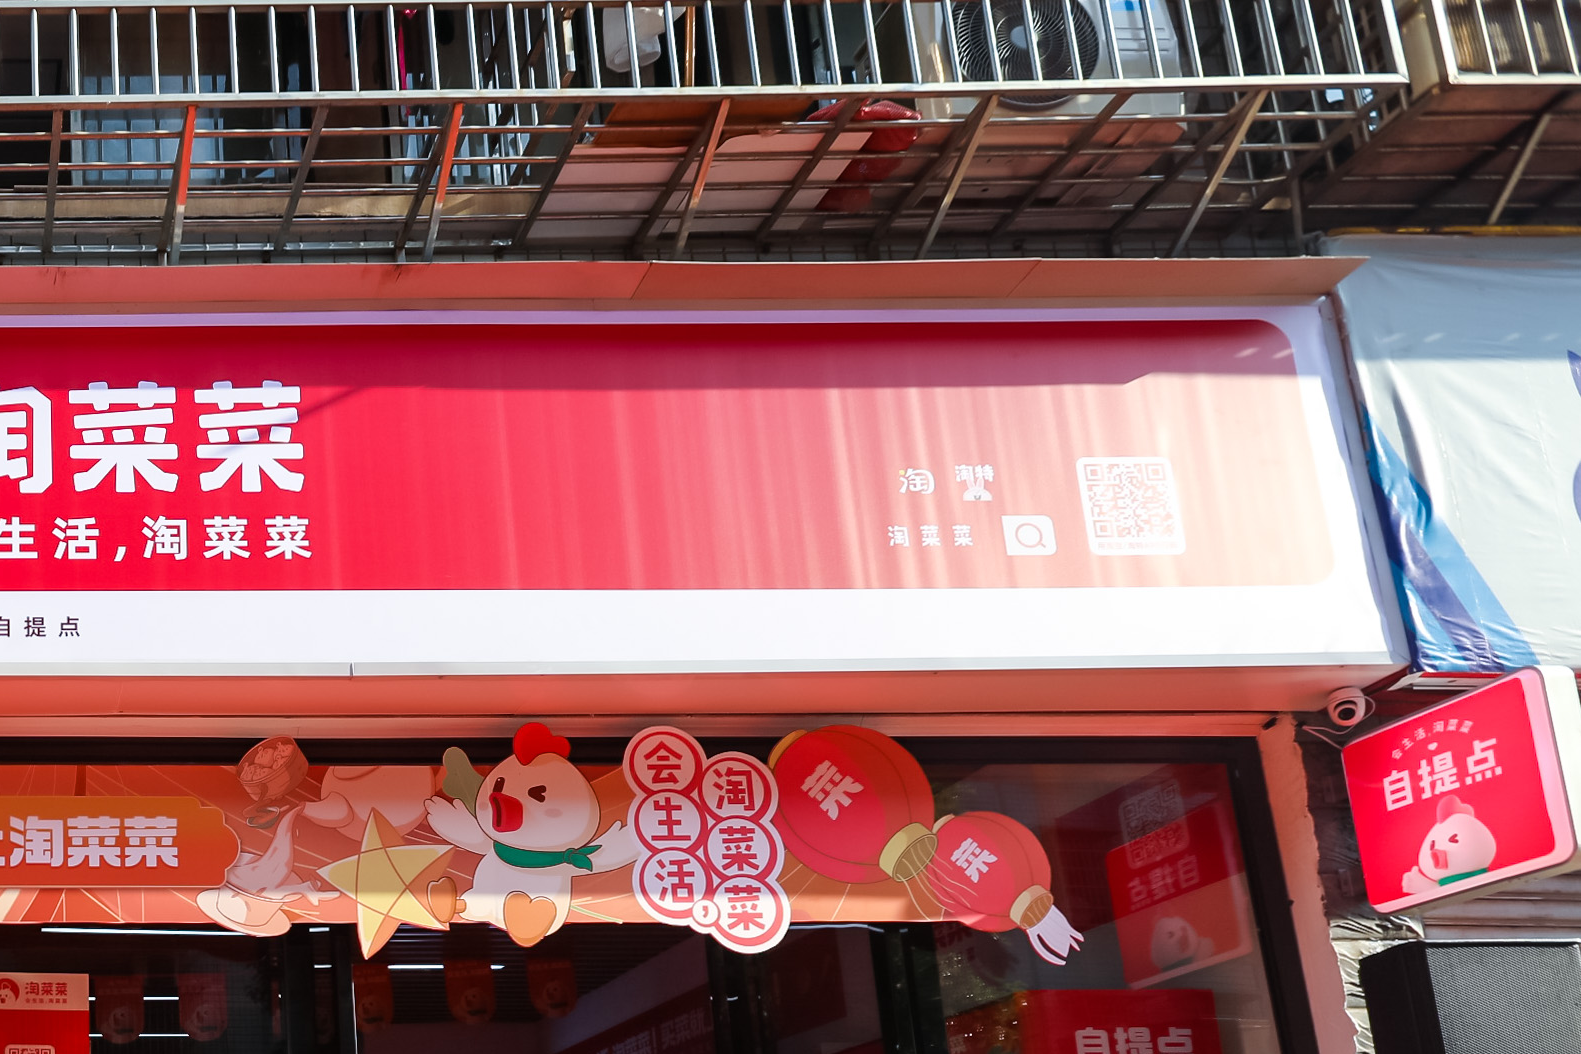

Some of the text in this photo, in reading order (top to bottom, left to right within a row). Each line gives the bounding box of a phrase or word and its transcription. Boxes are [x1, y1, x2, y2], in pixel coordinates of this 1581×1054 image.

[898, 468, 935, 495] 淘
[955, 464, 994, 483] 淘特
[887, 524, 974, 548] 淘菜菜
[1391, 717, 1474, 761] 会生活,淘菜菜
[800, 759, 865, 821] 菜
[1382, 738, 1503, 812] 自提点
[712, 766, 764, 932] 淘菜菜
[950, 837, 999, 884] 菜
[25, 981, 68, 996] 淘菜菜
